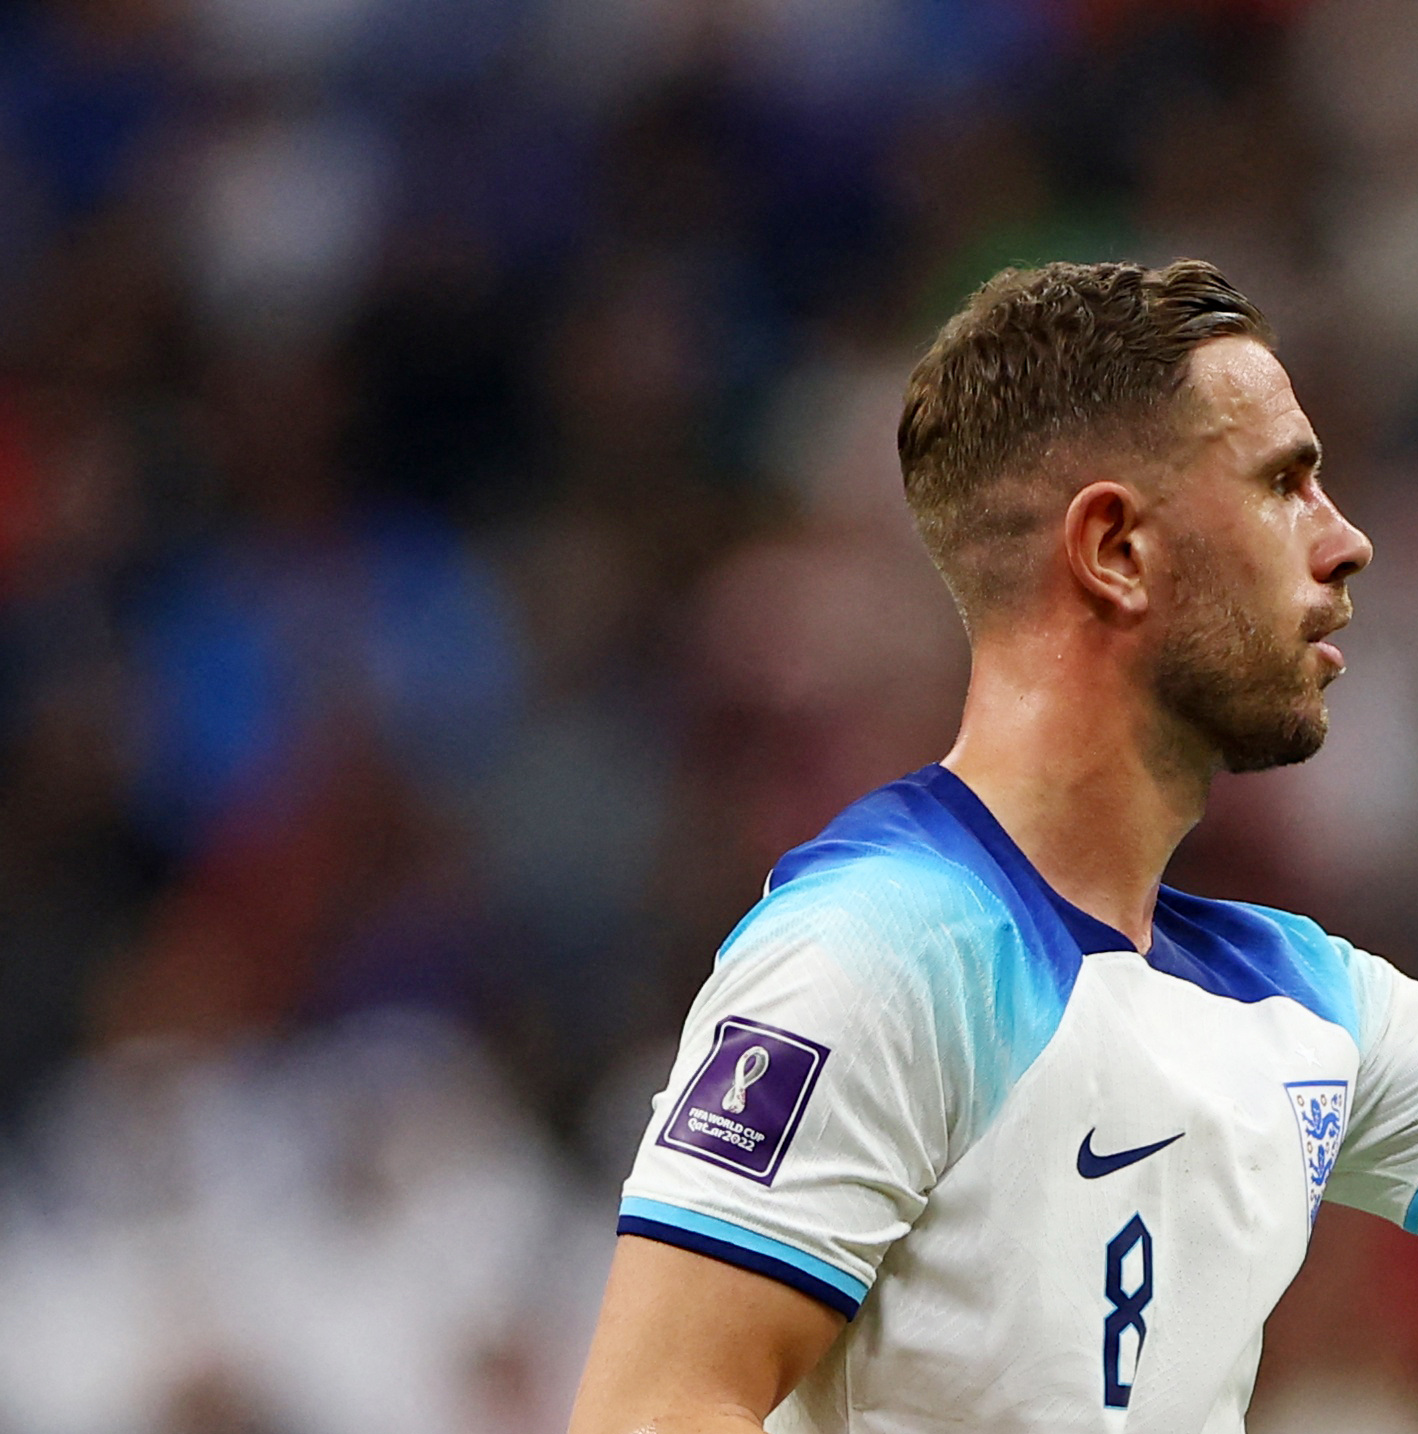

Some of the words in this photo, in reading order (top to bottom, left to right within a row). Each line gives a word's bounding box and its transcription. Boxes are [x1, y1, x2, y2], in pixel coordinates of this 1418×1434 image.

[688, 1107, 711, 1122] FIFA
[708, 1112, 744, 1134] WORLD
[743, 1126, 765, 1143] CUP
[1103, 1210, 1153, 1411] 8
